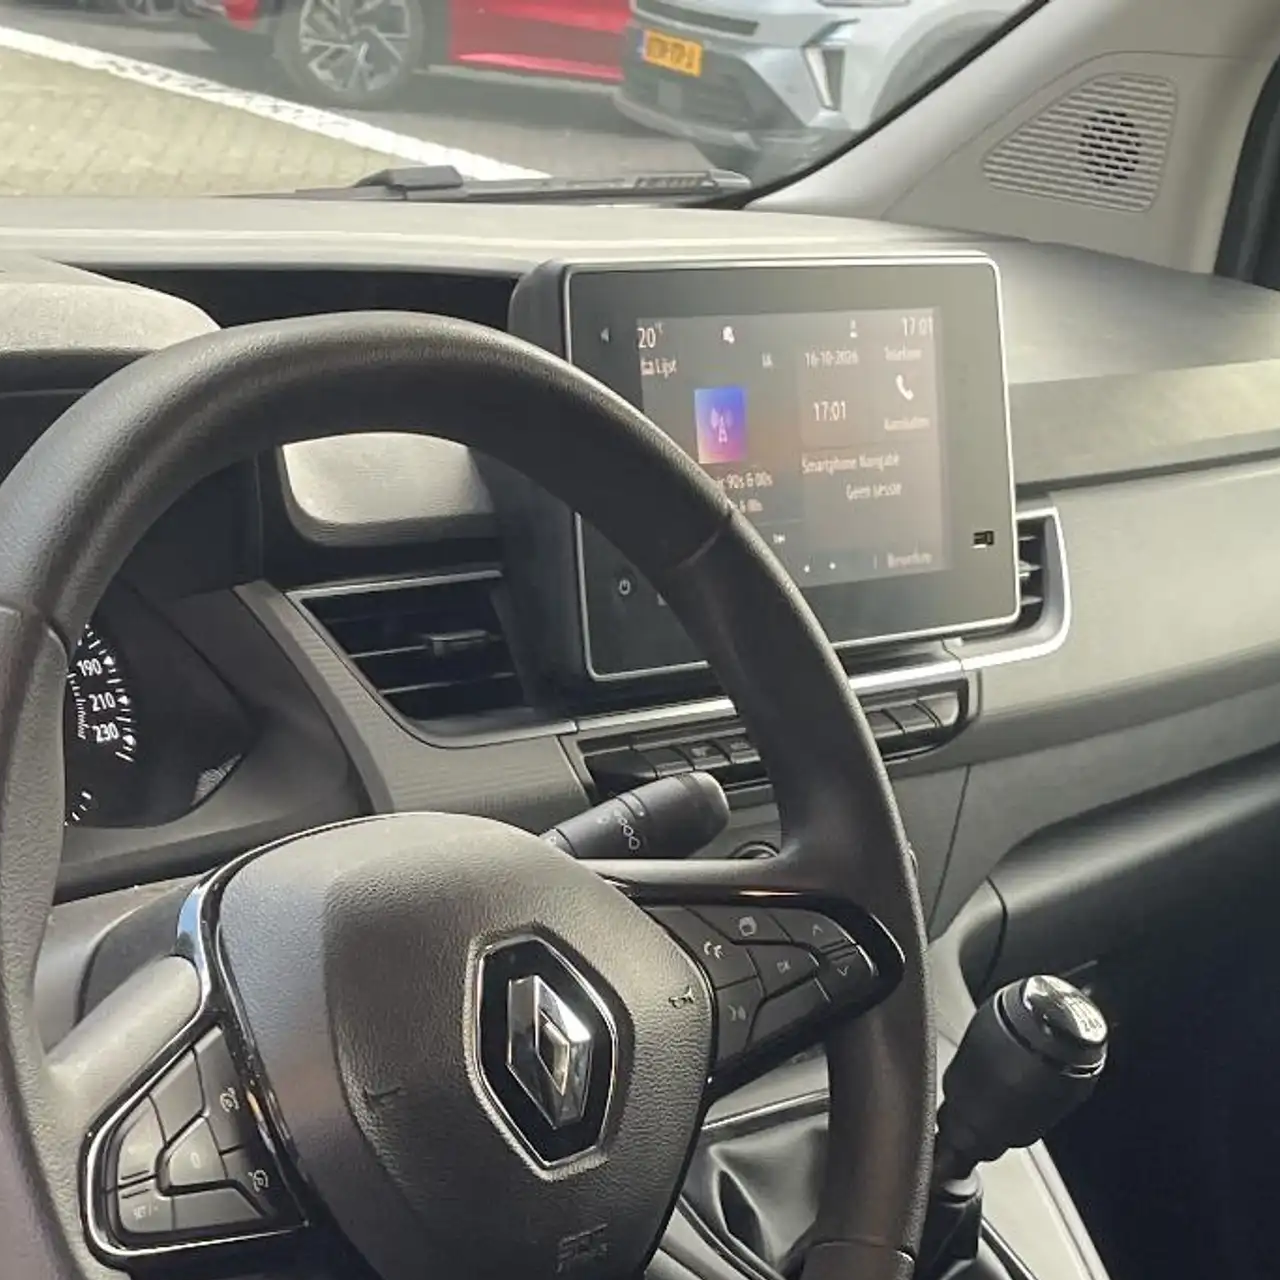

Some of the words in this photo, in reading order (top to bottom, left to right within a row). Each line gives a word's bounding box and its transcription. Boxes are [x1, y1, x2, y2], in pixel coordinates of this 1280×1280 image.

[814, 400, 846, 421] 17:01
[76, 657, 103, 677] 190
[88, 691, 117, 712] 210
[92, 721, 120, 743] 230
